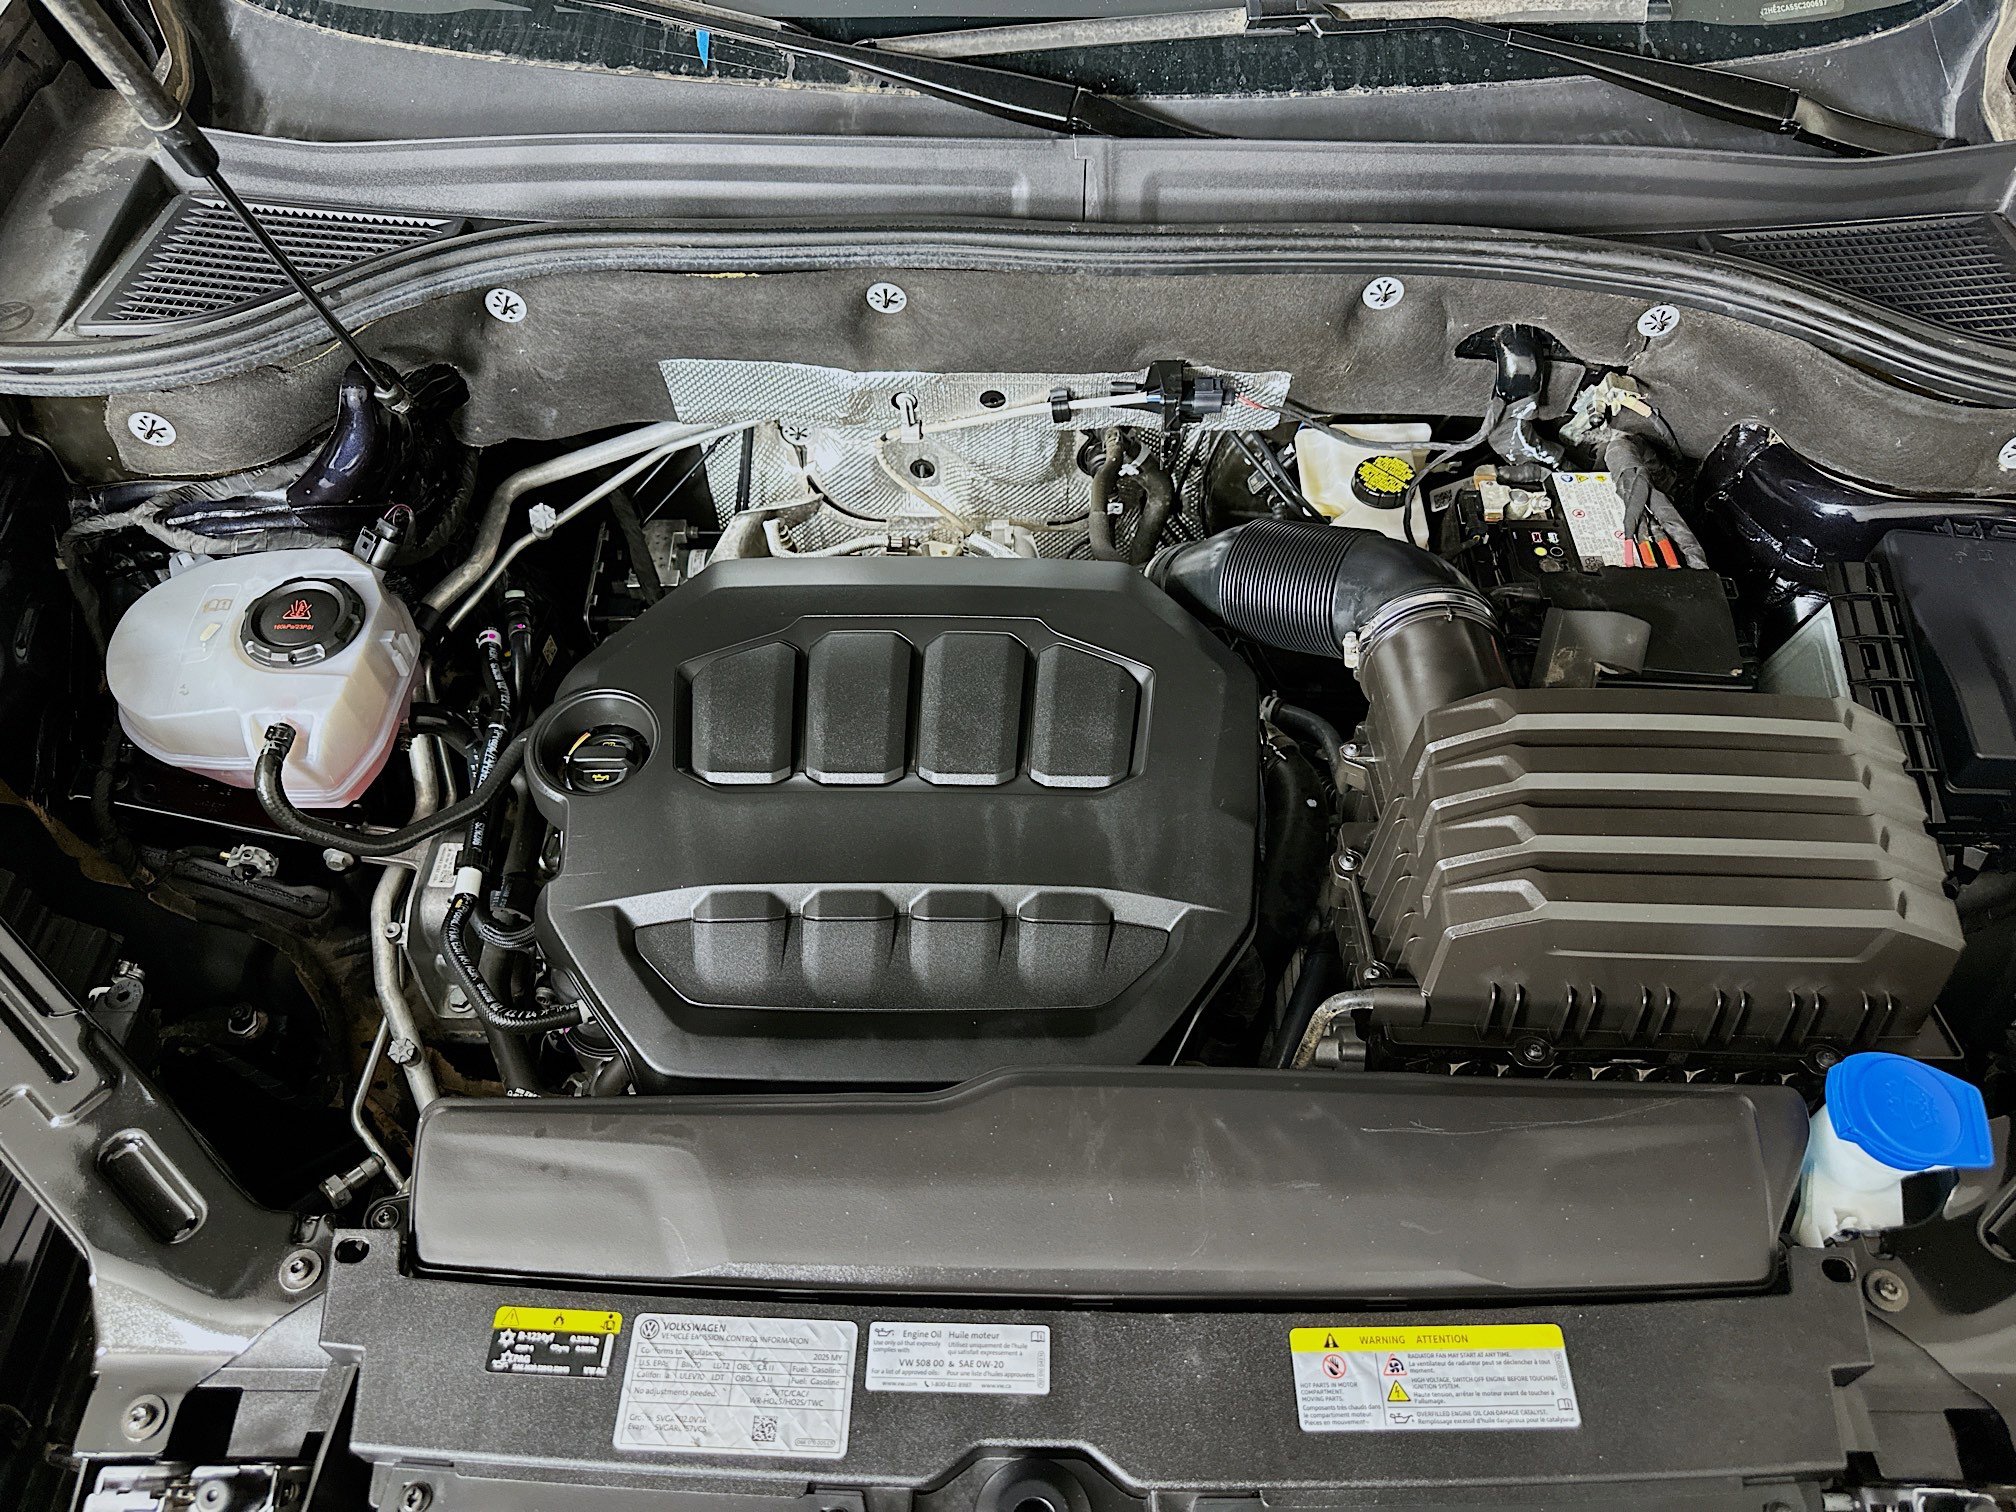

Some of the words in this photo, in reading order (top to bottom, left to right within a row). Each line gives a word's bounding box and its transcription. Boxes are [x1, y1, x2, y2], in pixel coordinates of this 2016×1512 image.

[663, 1321, 726, 1332] VOLKSWAGEN
[661, 1332, 690, 1340] VEHICLE
[691, 1333, 724, 1341] EMISSION
[726, 1335, 758, 1343] CONTROL
[760, 1336, 809, 1345] INFORMATION
[903, 1330, 929, 1339] Engine
[930, 1330, 942, 1338] Oil
[948, 1331, 969, 1339] Huile
[1359, 1335, 1405, 1344] WARNING
[1416, 1335, 1468, 1344] ATTENTION
[641, 1346, 673, 1355] Coforms
[813, 1353, 829, 1361] 2025
[915, 1359, 931, 1367] 508
[933, 1359, 944, 1367] 00
[959, 1360, 974, 1368] SAE
[976, 1360, 1004, 1368] 0W-20
[792, 1365, 809, 1373] Fuel:
[811, 1366, 841, 1374] Gasoline
[810, 1378, 839, 1386] Gasoline
[645, 1387, 688, 1397] adjustments
